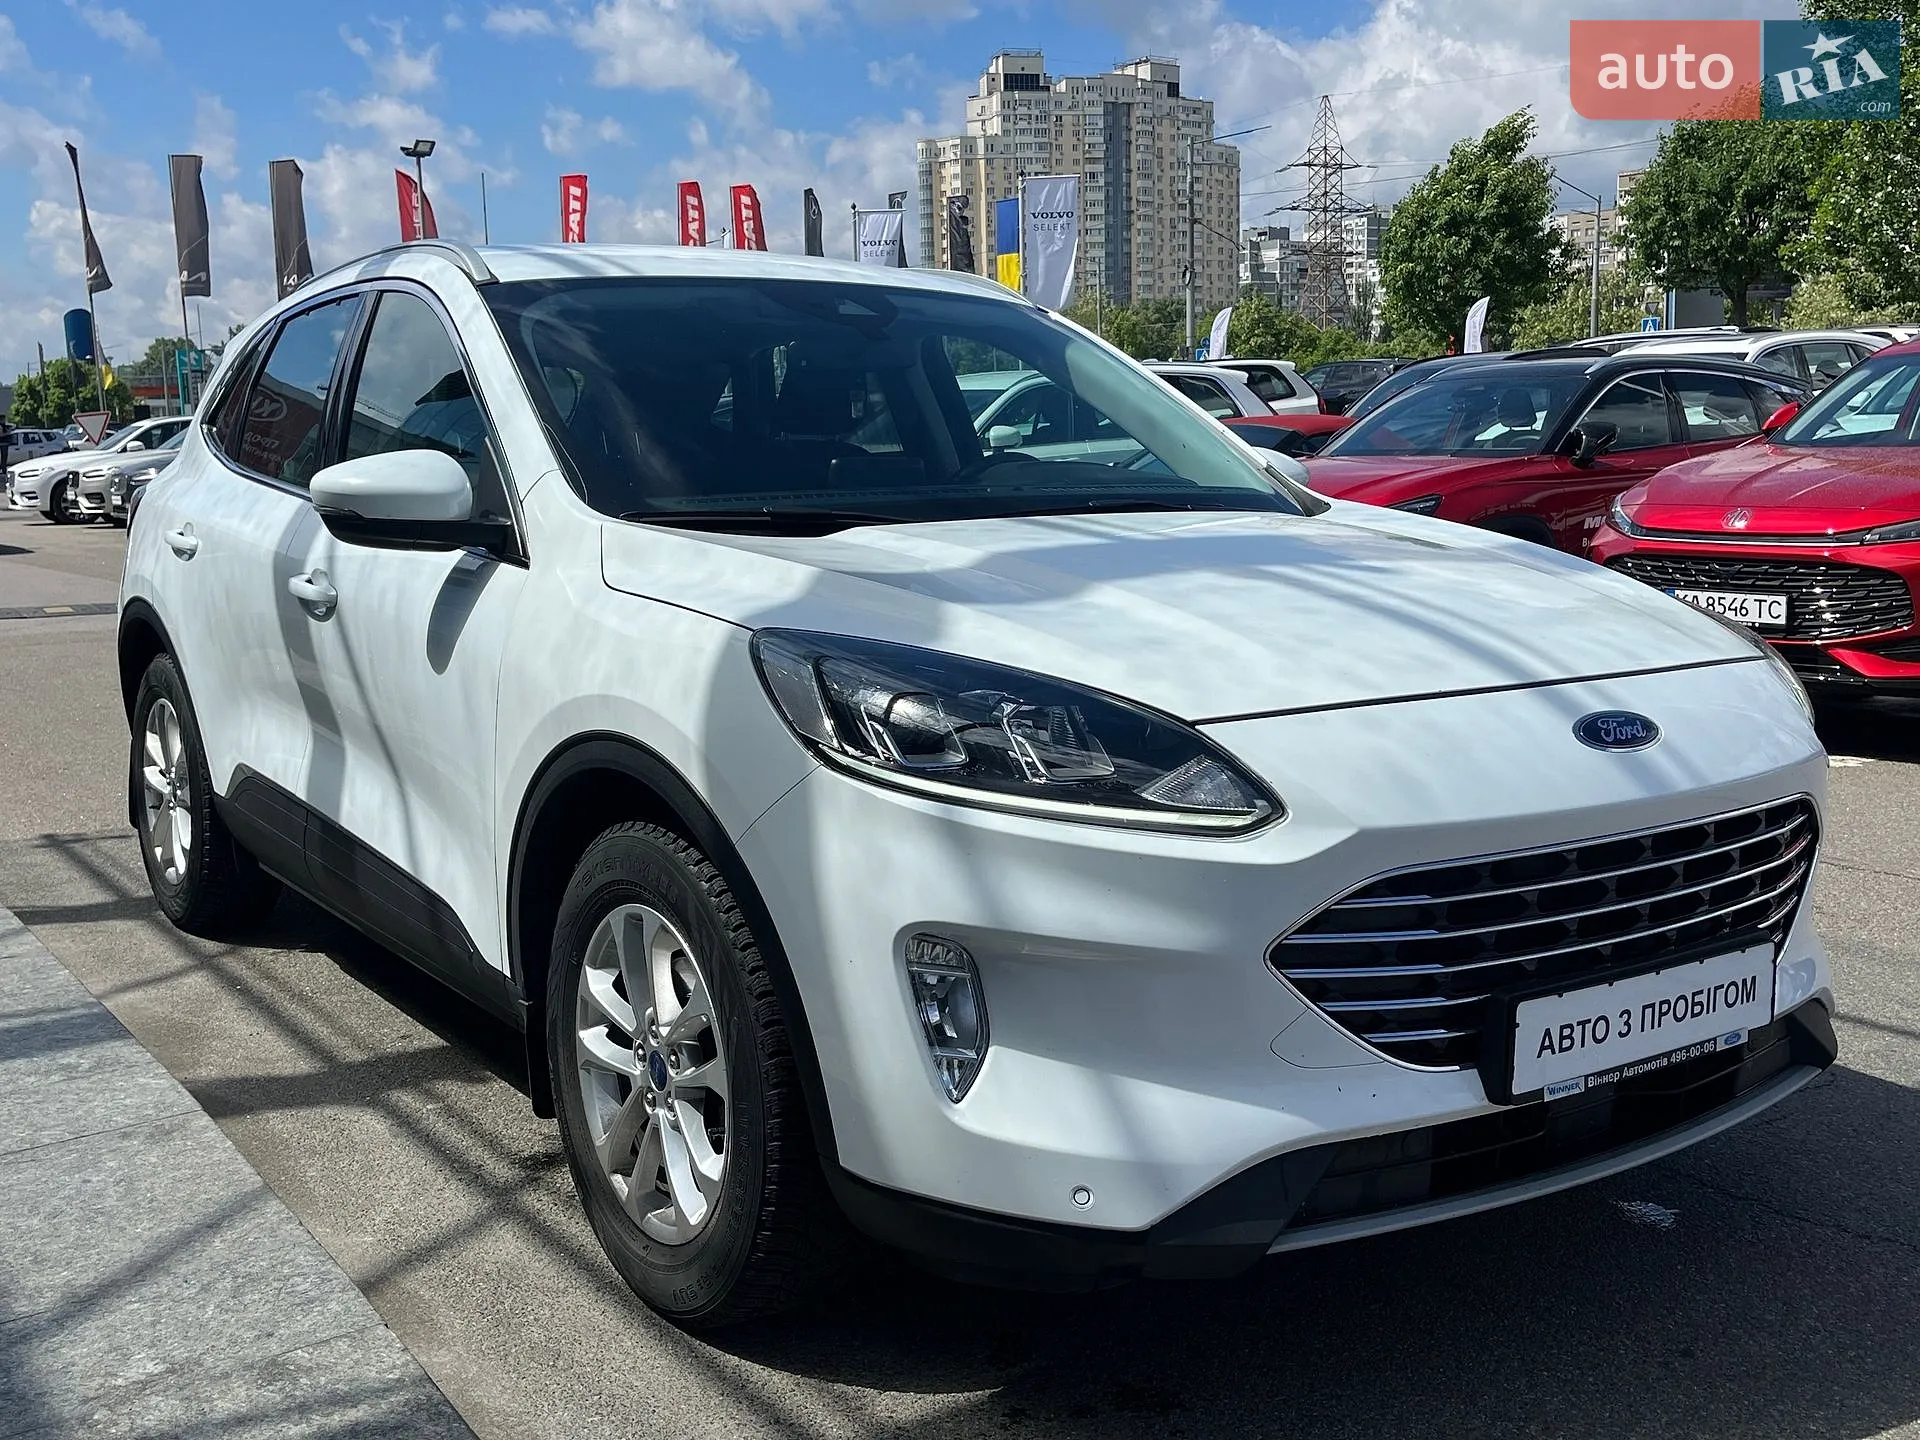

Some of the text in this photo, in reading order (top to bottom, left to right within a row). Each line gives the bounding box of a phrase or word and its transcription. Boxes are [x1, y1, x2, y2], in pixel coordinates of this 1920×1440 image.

[1031, 211, 1074, 219] VOLVO
[1033, 222, 1071, 231] SELEKT
[863, 249, 896, 258] SELEKT
[1706, 596, 1749, 617] 8546
[1597, 716, 1647, 742] Ford
[1536, 1014, 1611, 1059] АВТО
[1640, 975, 1758, 1033] ПРОБІГОМ
[1587, 1040, 1715, 1088] Віннер Автомотів 496-00-06
[1547, 1082, 1583, 1096] WINNER
